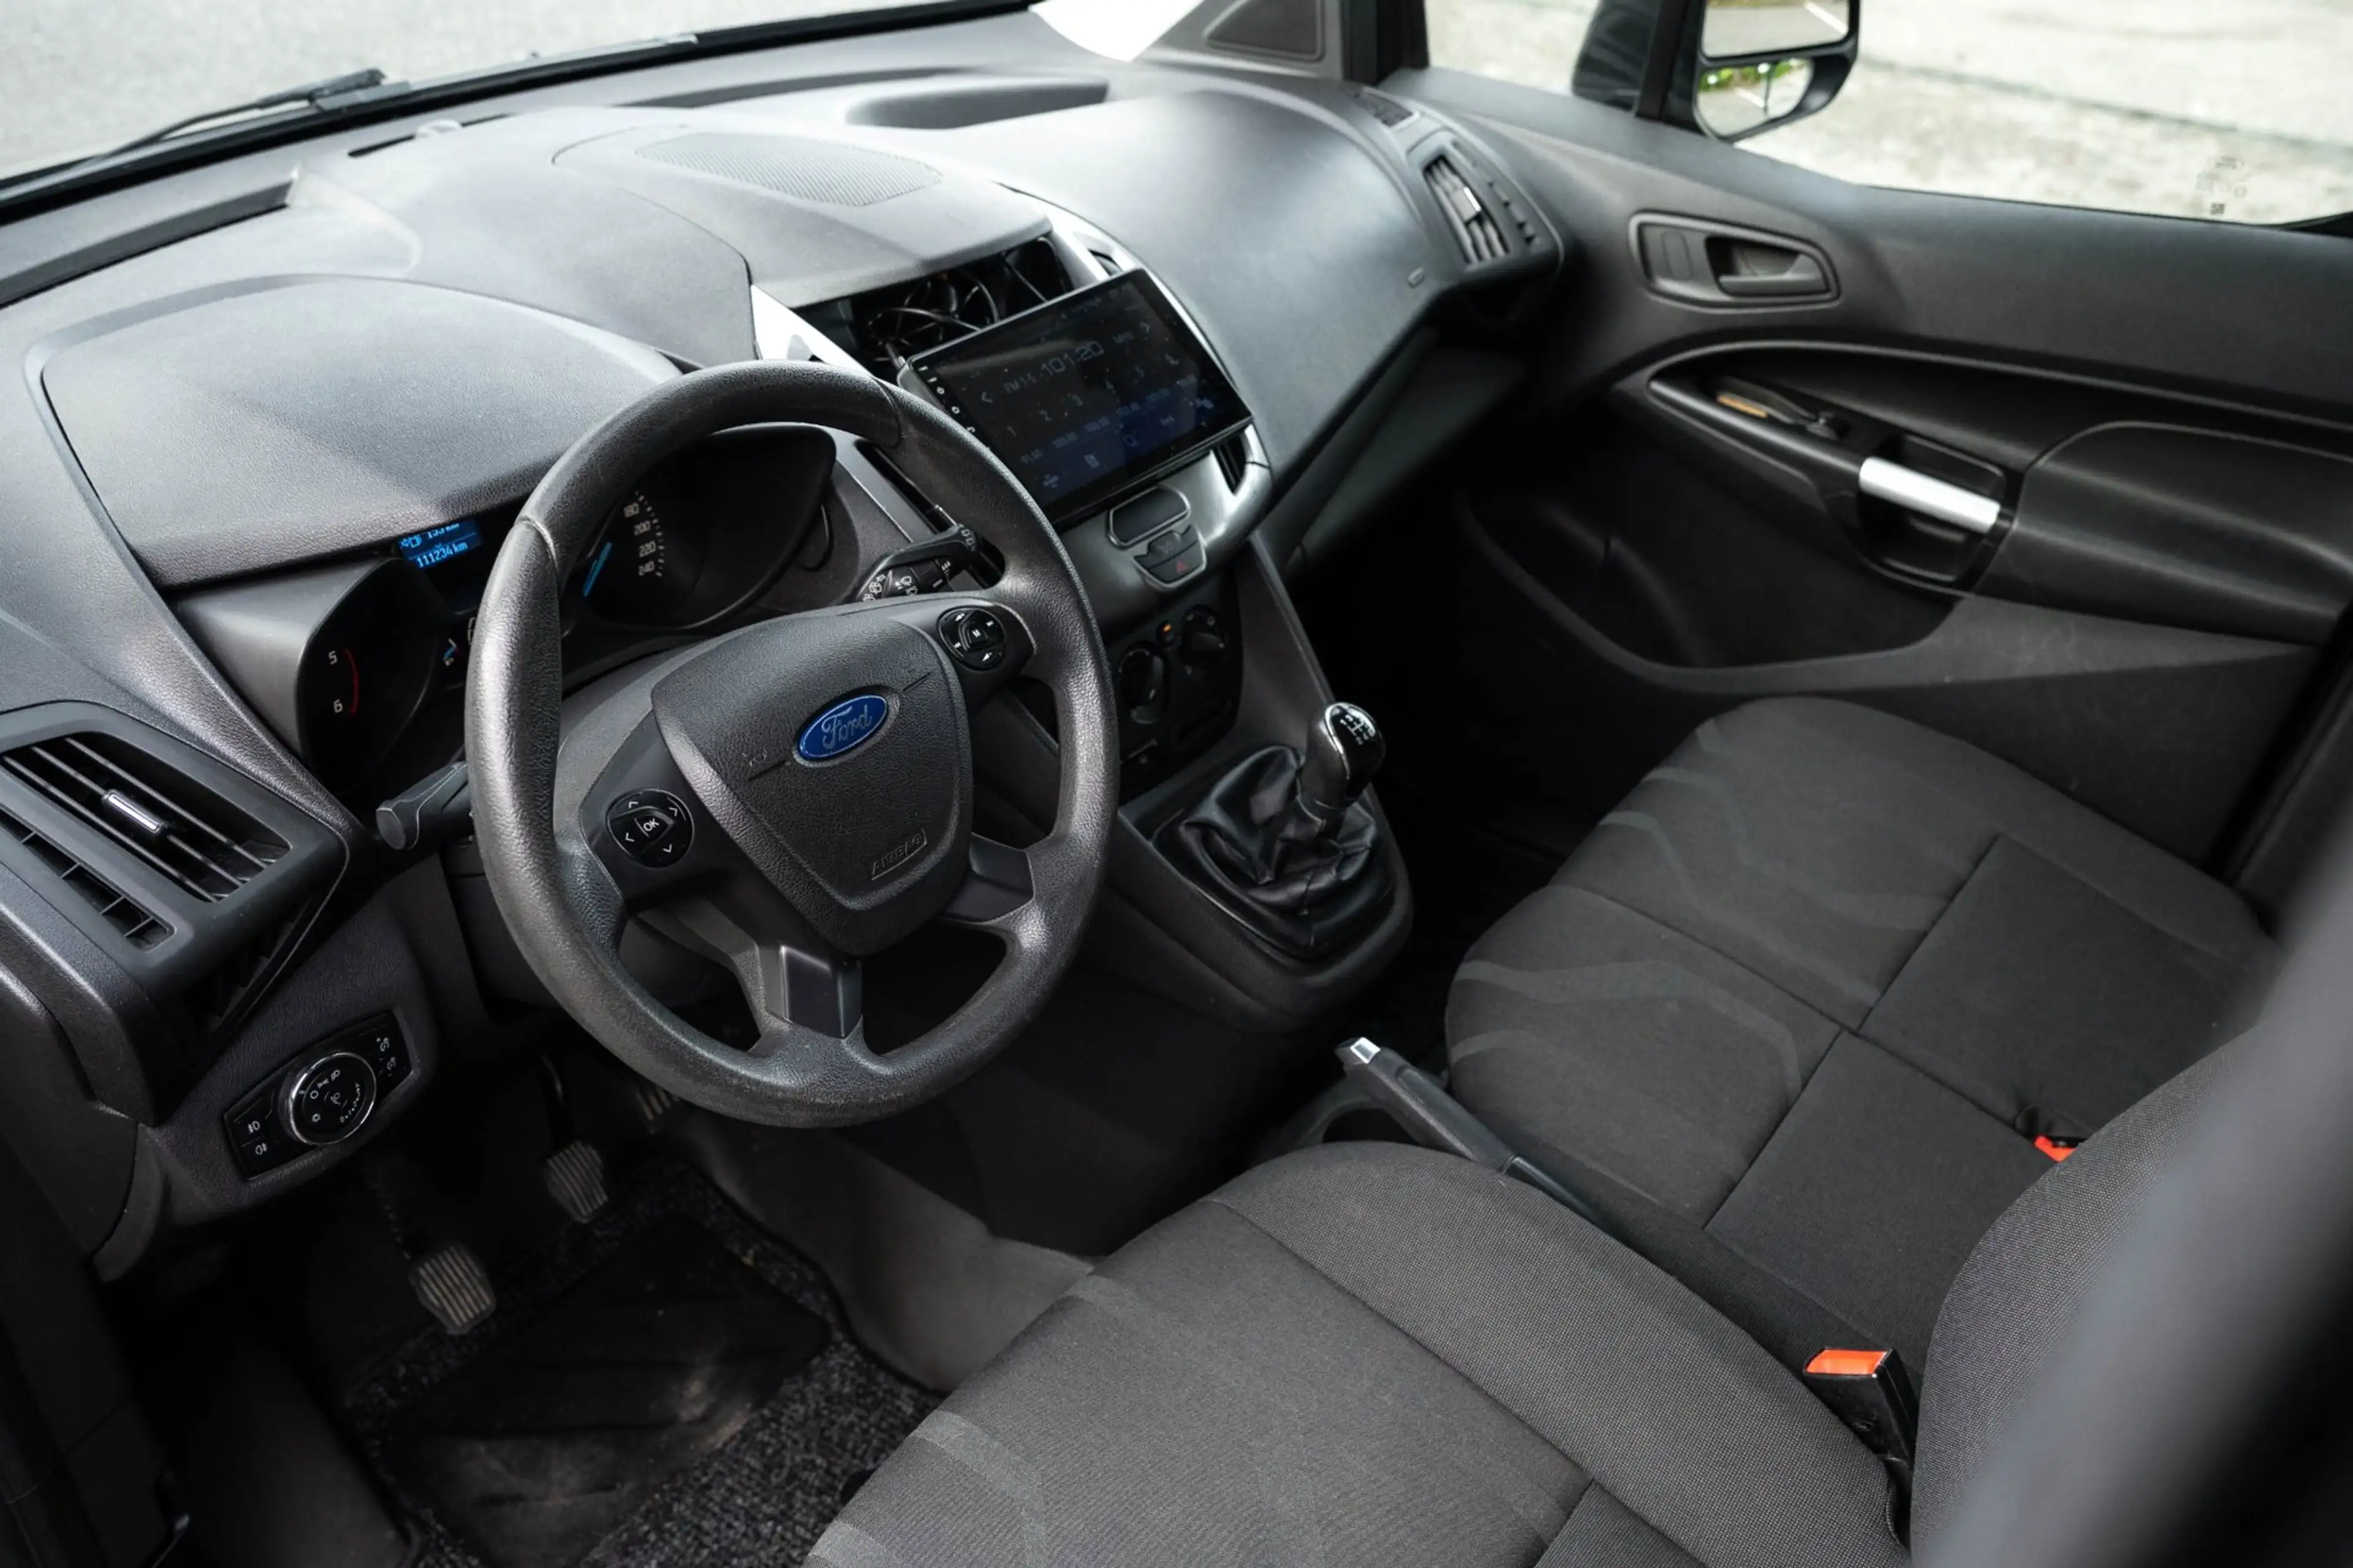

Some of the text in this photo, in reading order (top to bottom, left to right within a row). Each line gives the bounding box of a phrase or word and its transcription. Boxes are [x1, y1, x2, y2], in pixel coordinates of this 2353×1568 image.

[1007, 425, 1017, 436] 1
[1040, 409, 1052, 422] 2
[623, 502, 640, 518] 180
[633, 520, 651, 536] 200
[417, 542, 468, 569] 111234 km
[638, 540, 656, 558] 220
[638, 561, 656, 576] 240
[328, 650, 338, 665] 5
[333, 699, 343, 713] 6
[821, 705, 873, 750] Ford
[643, 818, 660, 832] OK
[871, 832, 923, 876] AIRBAG
